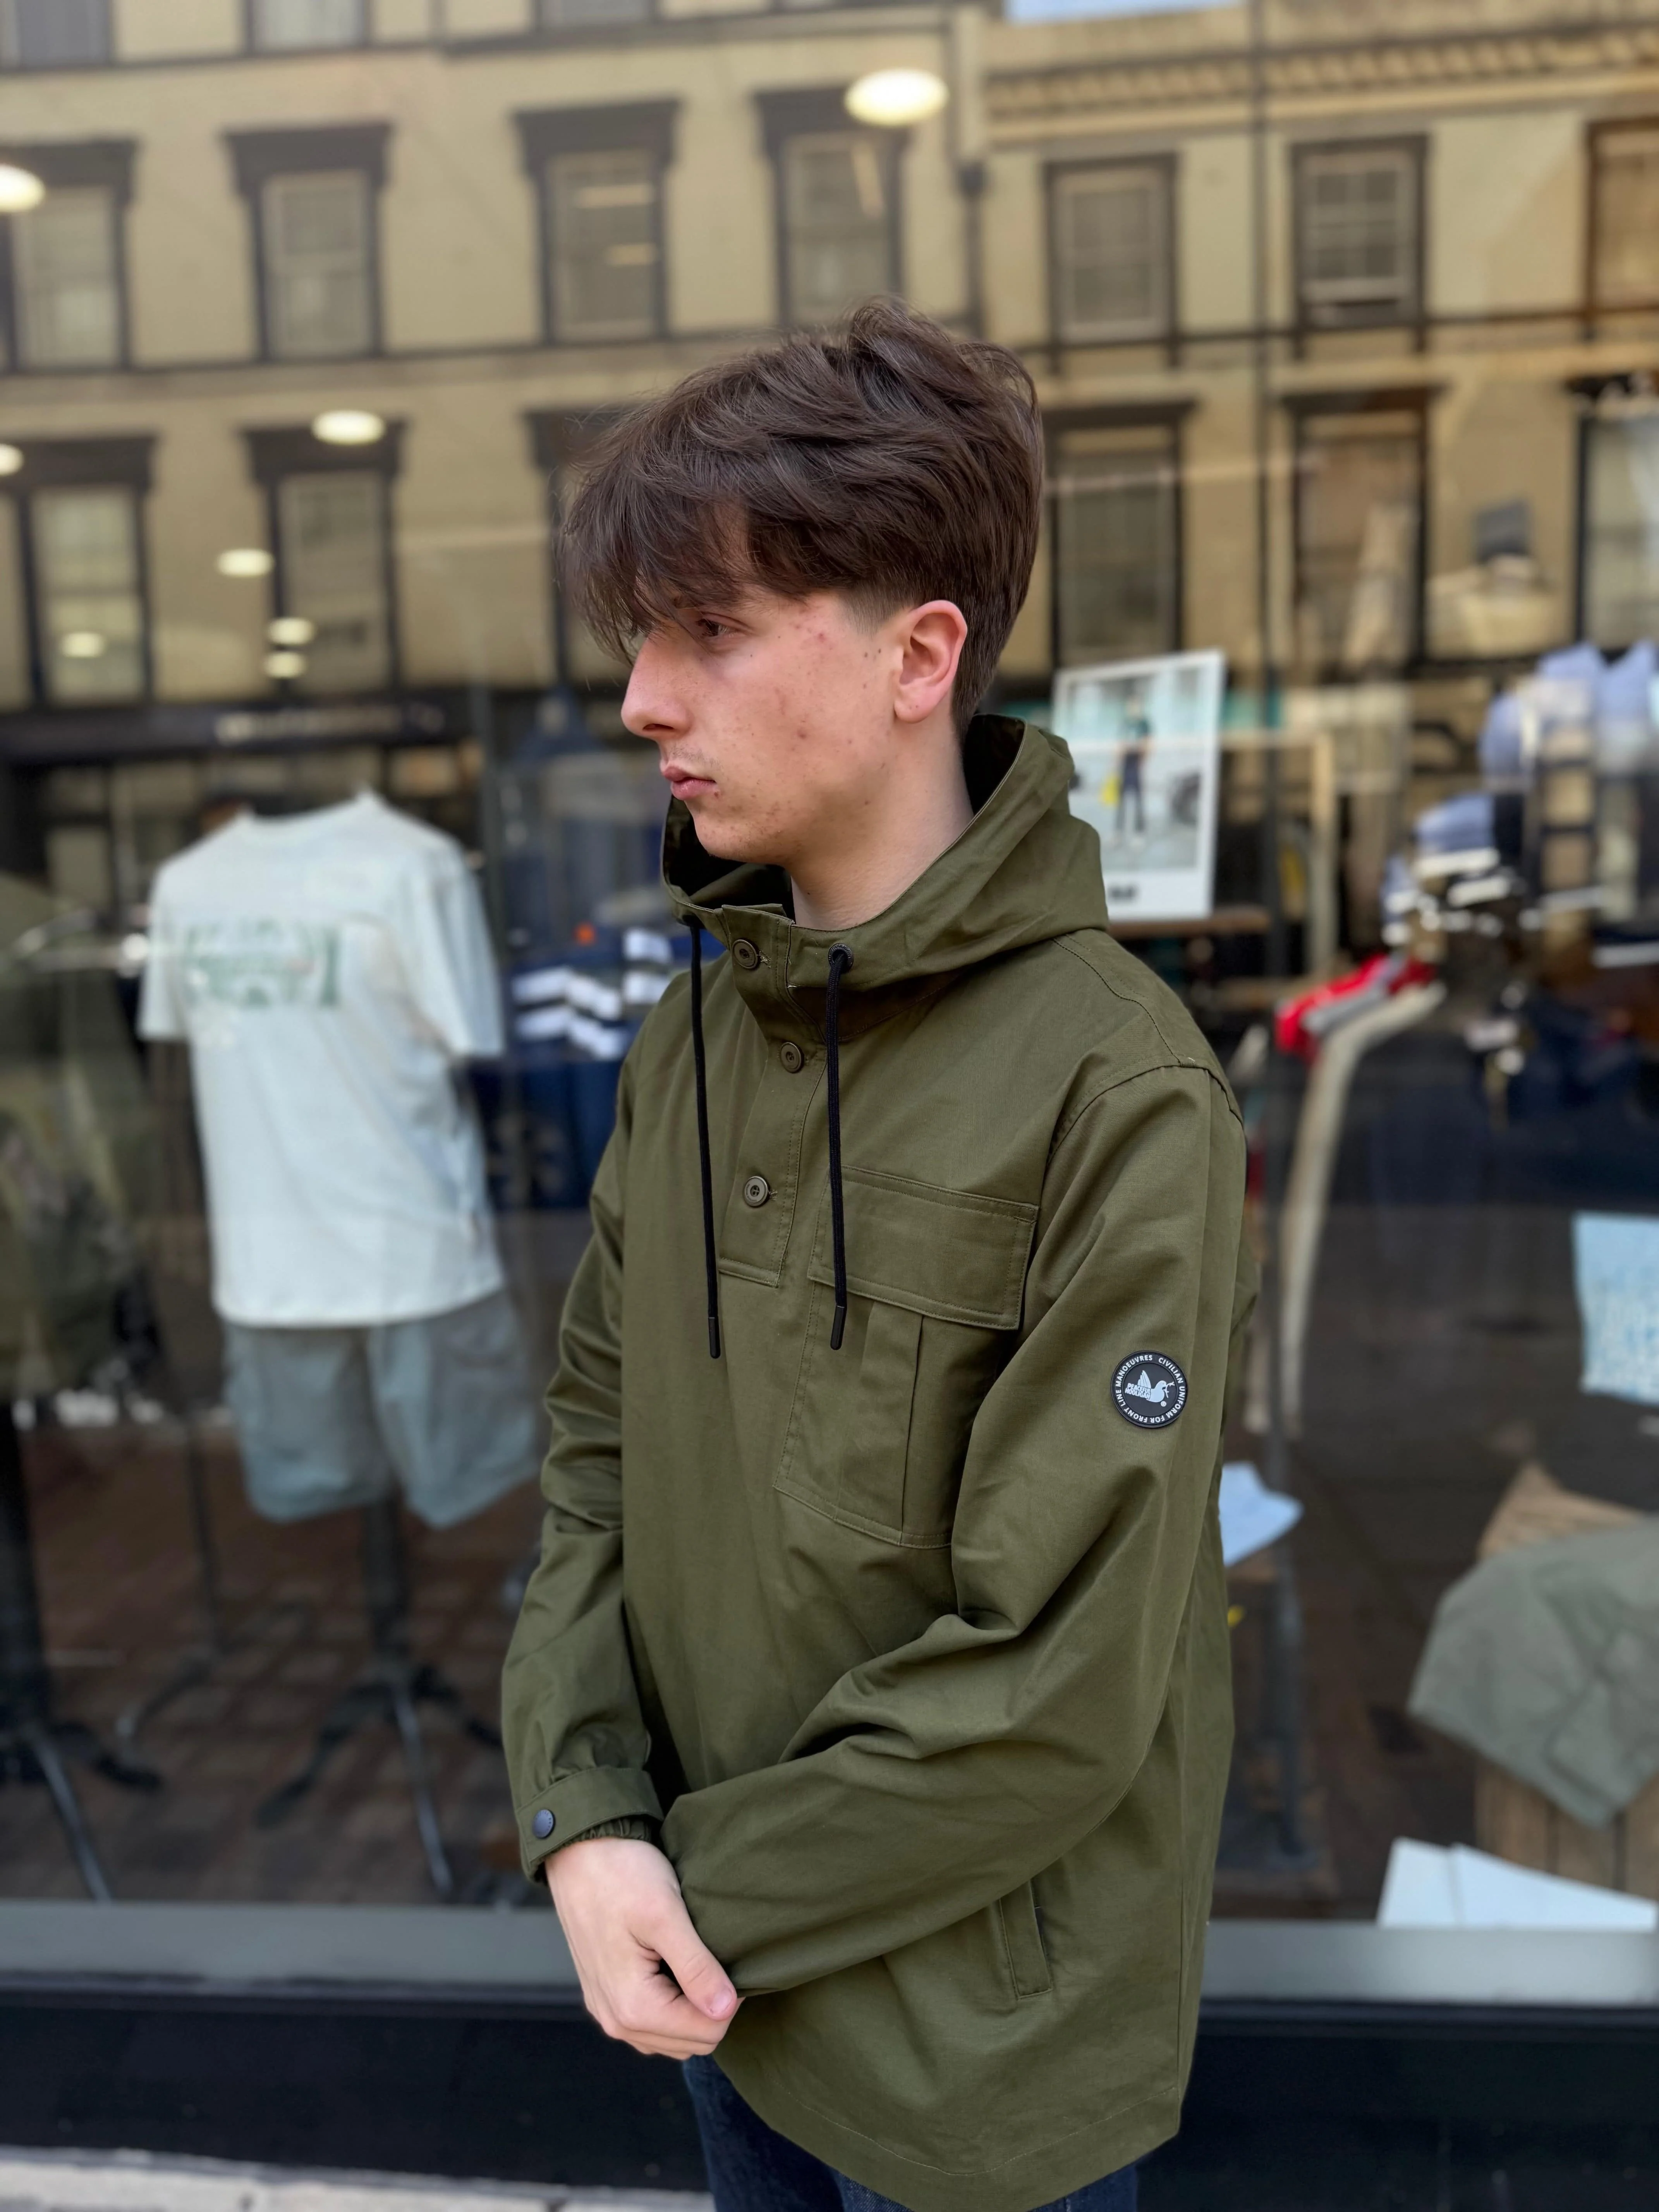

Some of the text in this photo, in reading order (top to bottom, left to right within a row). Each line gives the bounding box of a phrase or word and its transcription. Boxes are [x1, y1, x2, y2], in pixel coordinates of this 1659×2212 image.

[1115, 1355, 1152, 1387] MANOEUVRES
[1158, 1357, 1184, 1383] CIVILIAN
[1125, 1388, 1151, 1399] HOOLIGAN
[1127, 1383, 1151, 1393] PEACEFUL
[1116, 1389, 1126, 1407] LINE
[1166, 1386, 1185, 1419] UNIFORM
[1124, 1407, 1148, 1423] FRONT
